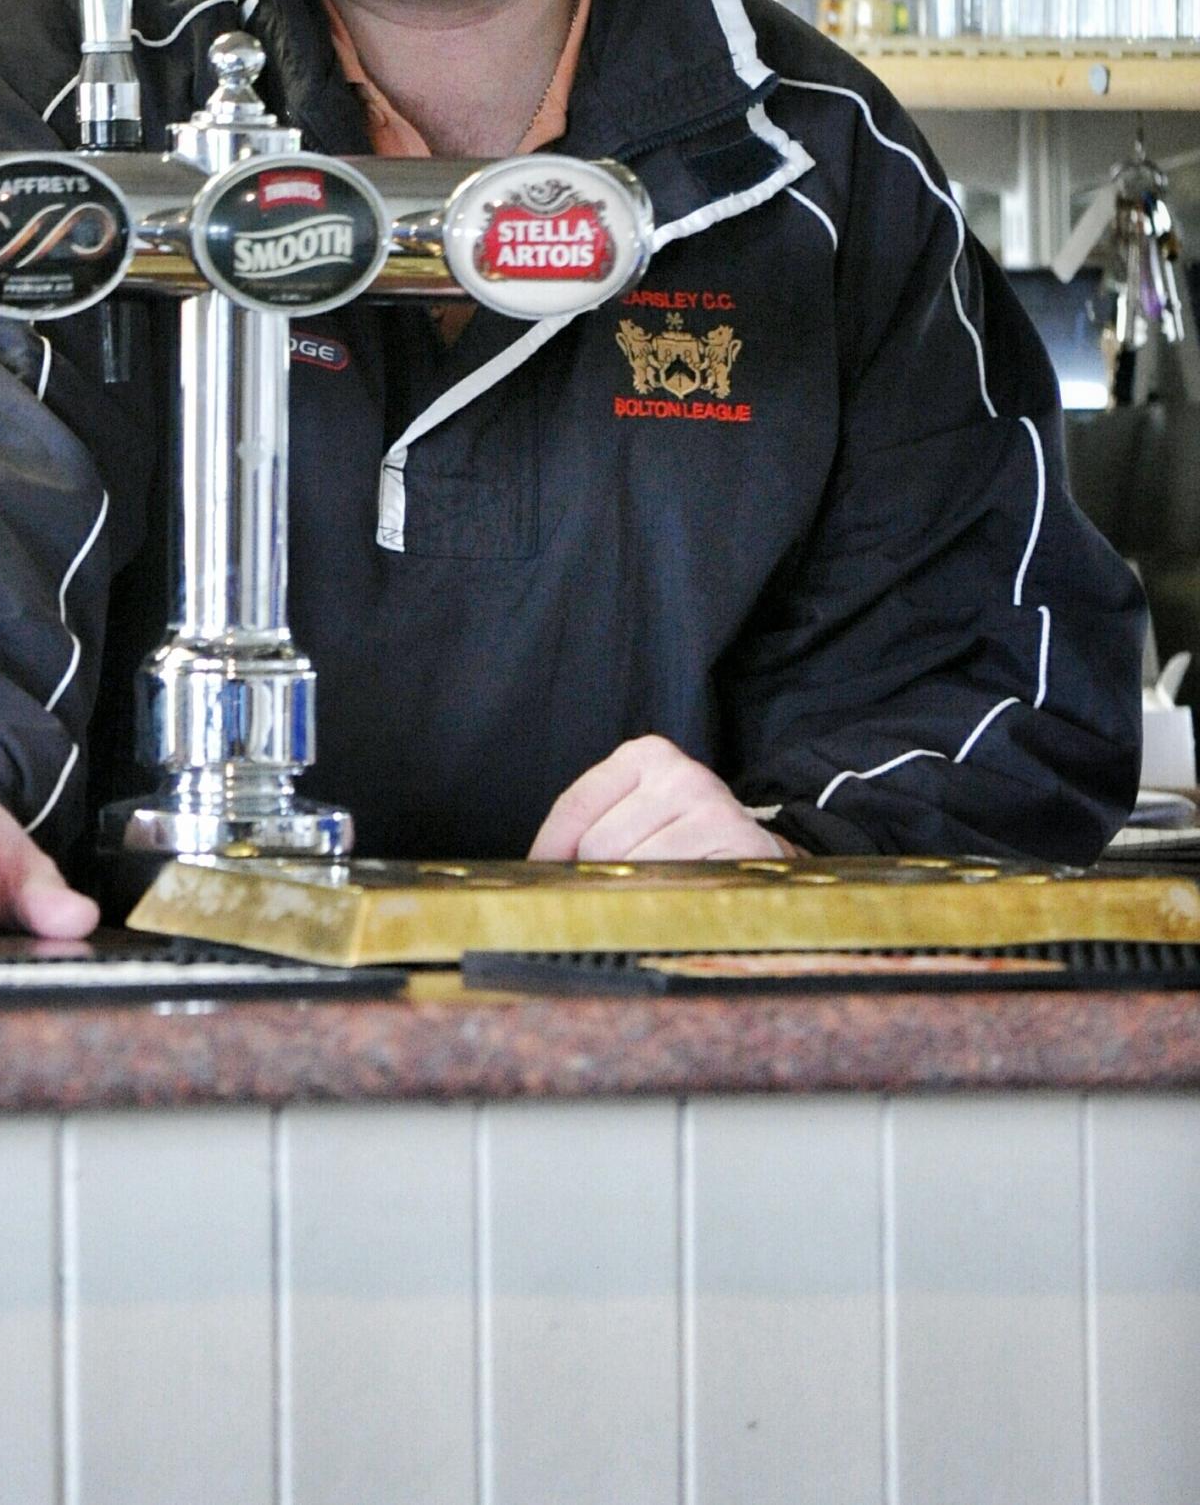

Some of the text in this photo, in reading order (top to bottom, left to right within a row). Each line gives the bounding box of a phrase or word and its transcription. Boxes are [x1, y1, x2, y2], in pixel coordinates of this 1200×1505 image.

[497, 219, 594, 242] STELLA
[233, 224, 353, 272] SMOOTH
[496, 245, 594, 267] ARTOIS
[622, 290, 698, 309] ARSLEY
[614, 397, 752, 422] BOLTON LEAGUE
